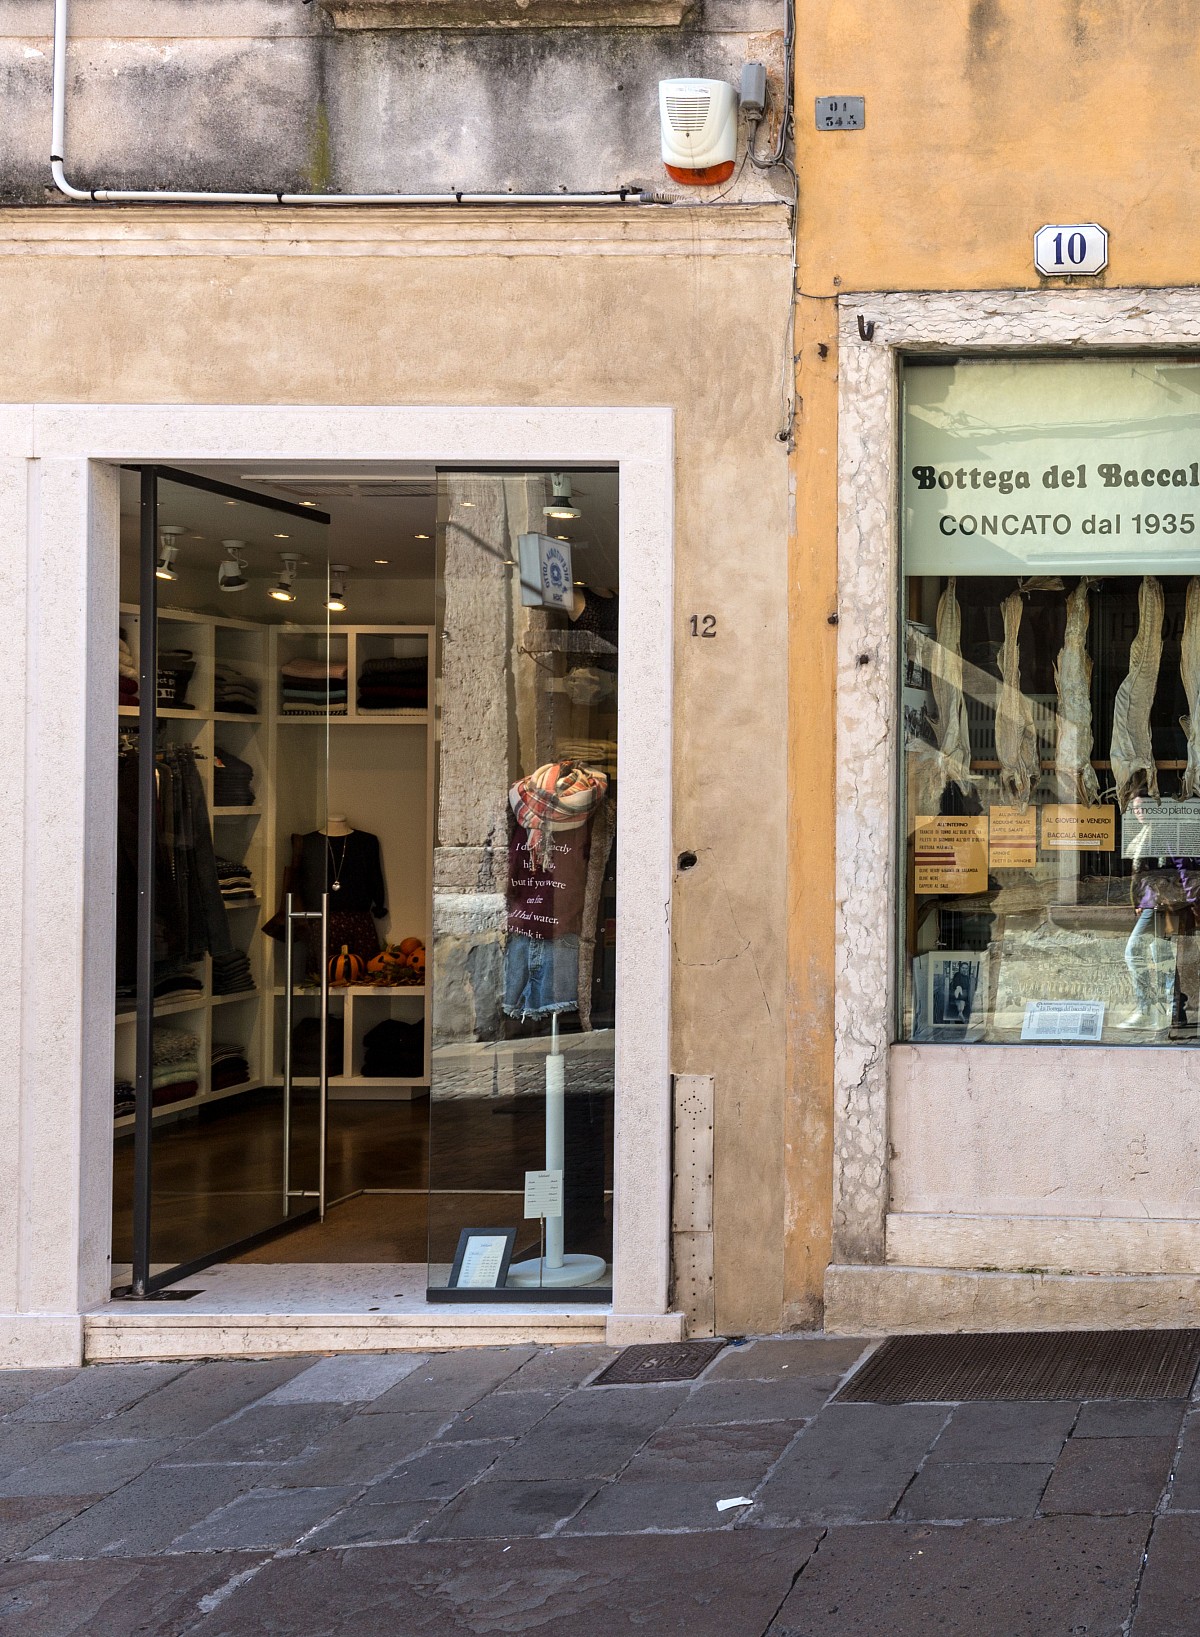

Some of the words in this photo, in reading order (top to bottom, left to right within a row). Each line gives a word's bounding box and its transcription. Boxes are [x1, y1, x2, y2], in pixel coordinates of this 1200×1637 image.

[1052, 232, 1087, 265] 10
[911, 464, 1031, 494] Bottega
[1041, 464, 1087, 490] del
[939, 513, 1072, 536] CONCATO
[1081, 513, 1121, 535] dal
[1131, 513, 1195, 535] 1935
[690, 614, 717, 638] 12
[1168, 805, 1193, 816] piatto
[511, 879, 526, 887] but
[527, 877, 535, 887] if
[545, 879, 567, 889] were
